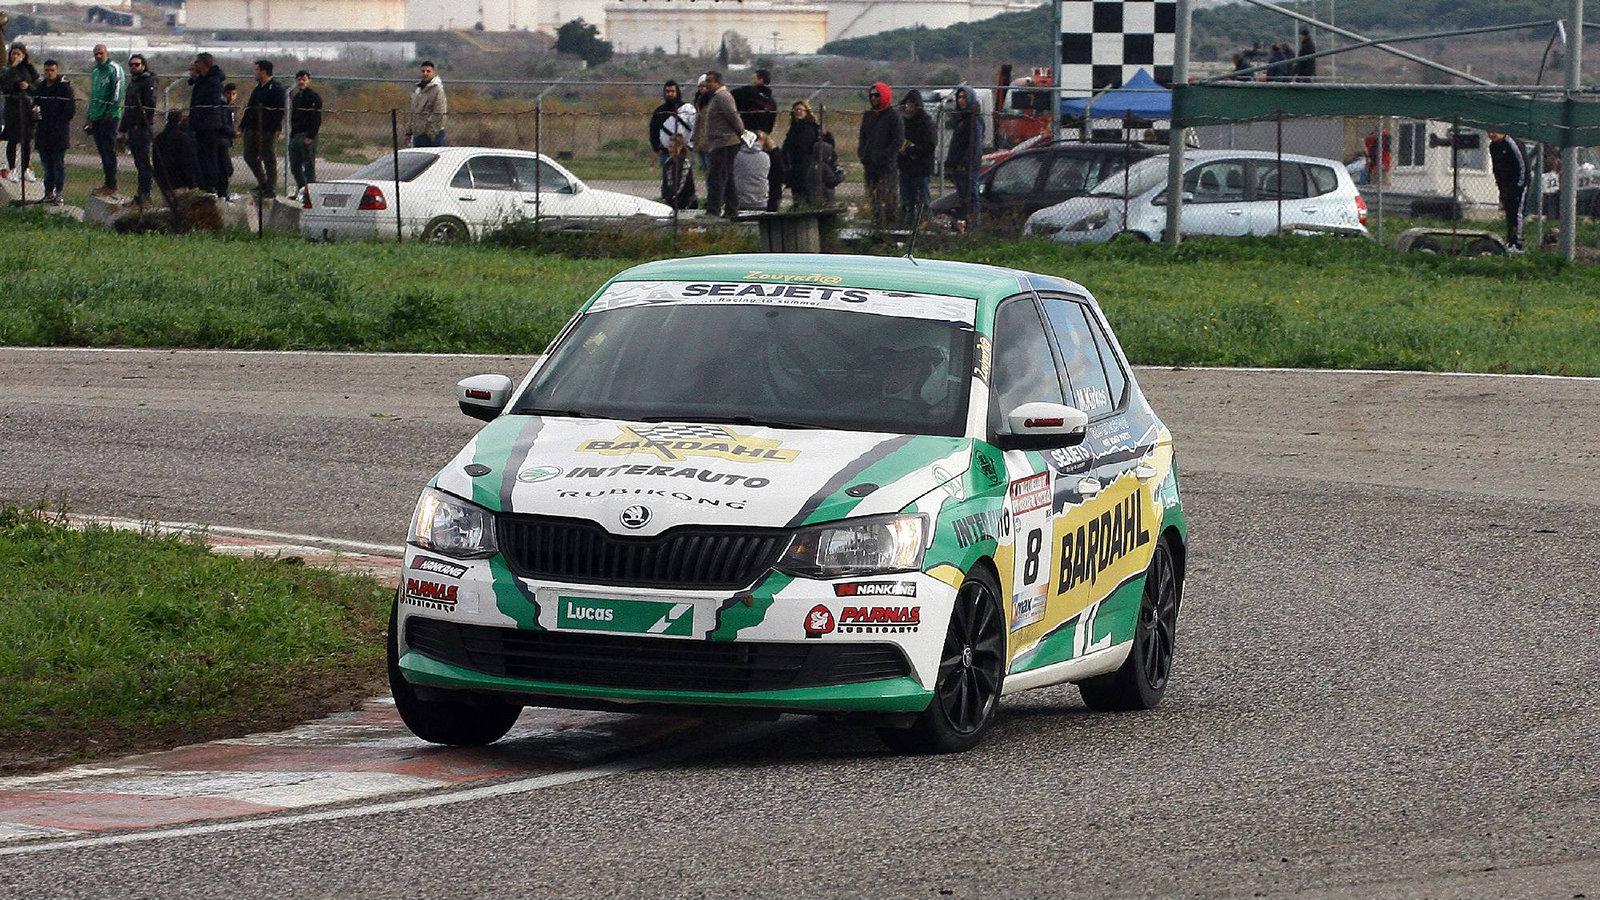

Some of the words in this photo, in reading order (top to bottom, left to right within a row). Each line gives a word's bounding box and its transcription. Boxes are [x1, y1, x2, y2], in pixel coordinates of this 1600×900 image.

[681, 284, 870, 303] SEAJETS
[585, 439, 789, 460] BARDAHL
[564, 464, 771, 489] INTERAUTO
[1057, 488, 1150, 596] BARDAHL
[1023, 527, 1042, 586] 8
[419, 560, 465, 577] NANKANG
[406, 578, 459, 602] PARNAS
[857, 584, 916, 596] NANKANG
[566, 601, 614, 621] Lucas
[839, 606, 921, 623] PARNAS
